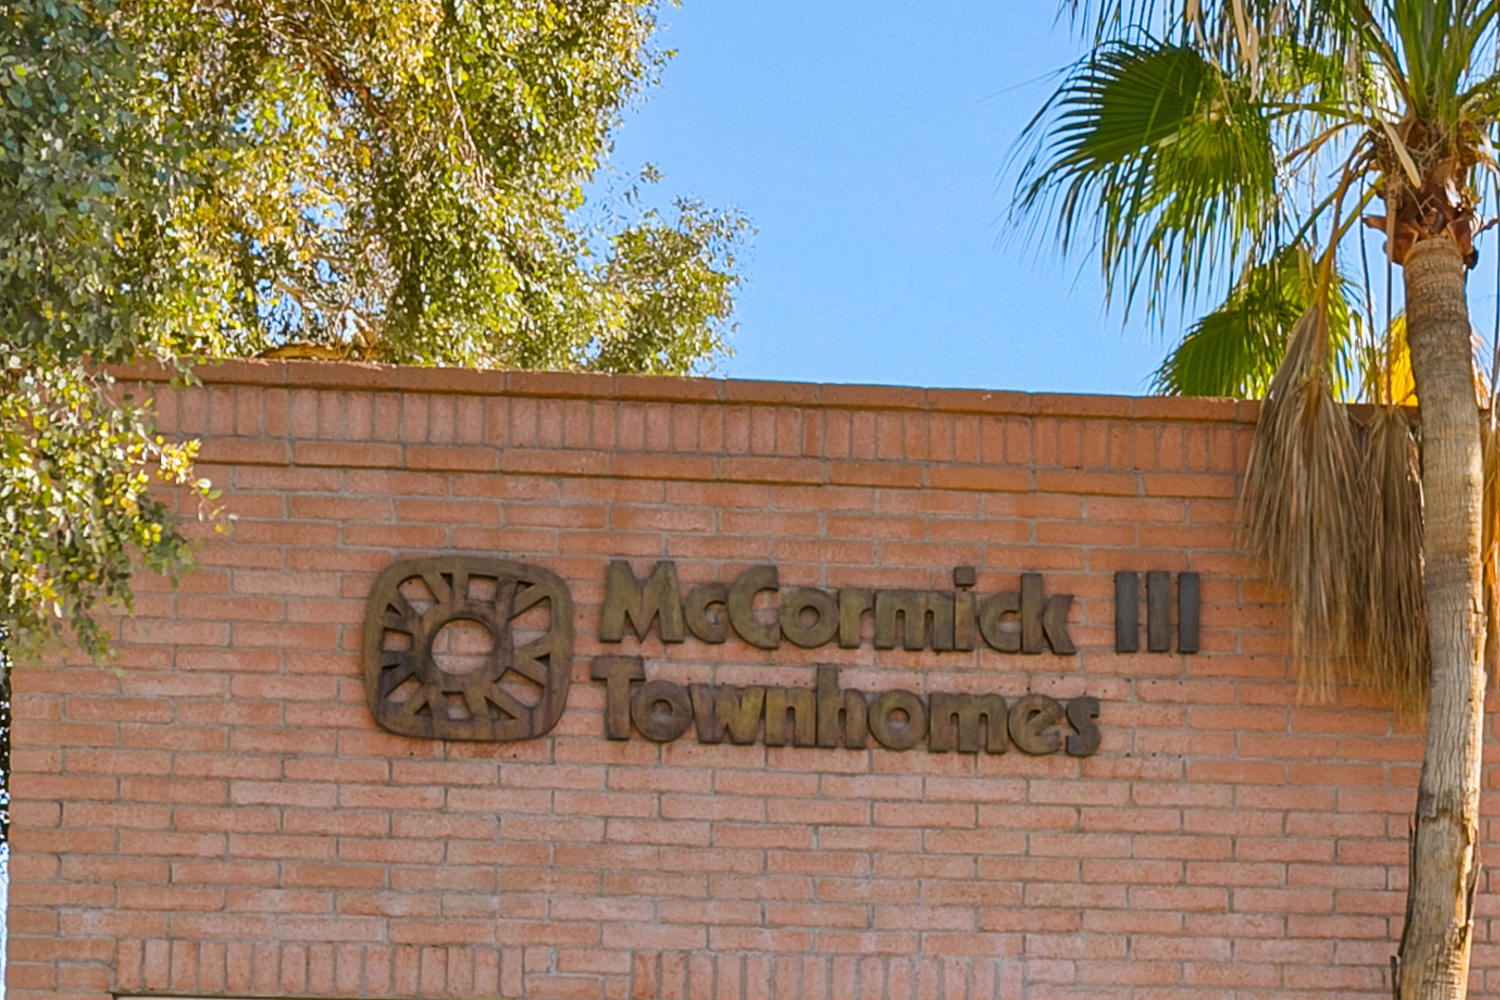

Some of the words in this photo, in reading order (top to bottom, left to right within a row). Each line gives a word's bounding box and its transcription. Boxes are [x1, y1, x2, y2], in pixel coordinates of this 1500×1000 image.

[600, 560, 1076, 656] McCormick
[1114, 570, 1200, 654] III
[591, 655, 1102, 757] Townhomes
